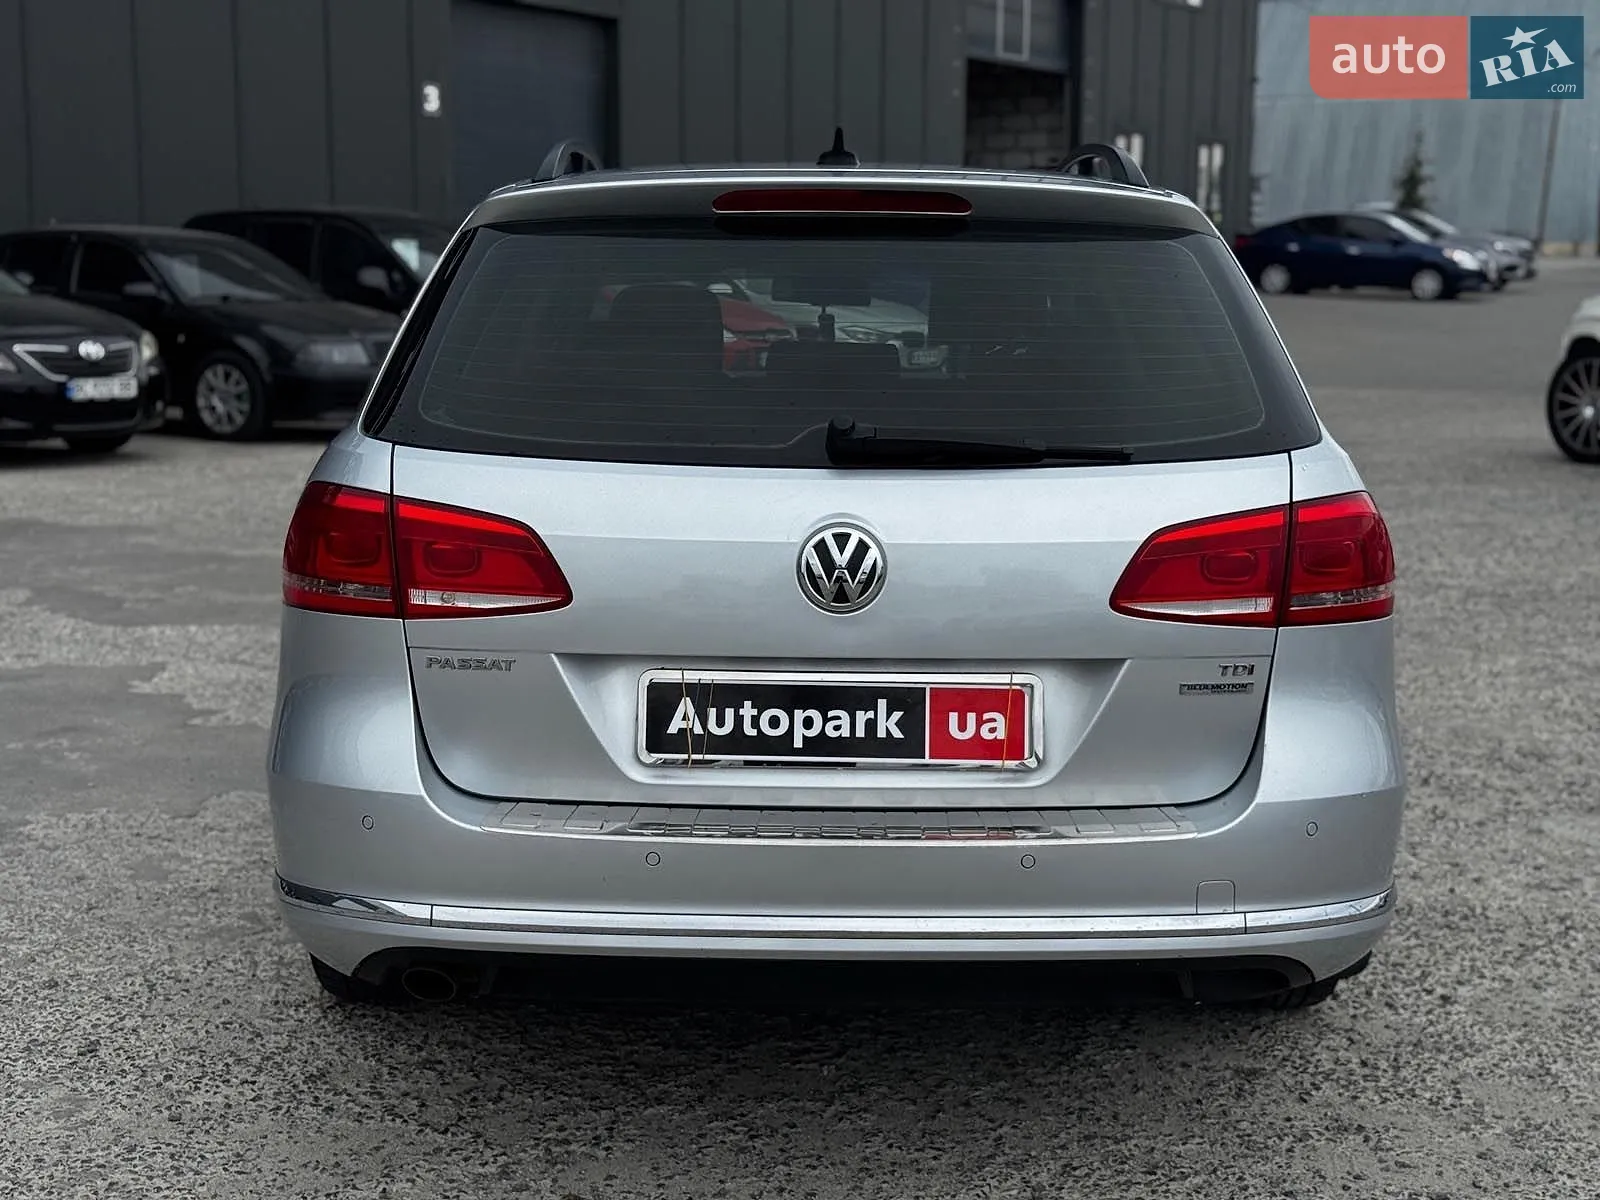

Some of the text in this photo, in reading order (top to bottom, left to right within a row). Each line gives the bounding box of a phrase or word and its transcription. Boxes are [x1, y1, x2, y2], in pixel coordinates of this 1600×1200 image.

[422, 84, 441, 113] 3
[425, 655, 517, 672] PASSAT
[1219, 663, 1255, 677] TDI
[666, 696, 1008, 748] Autopark ua
